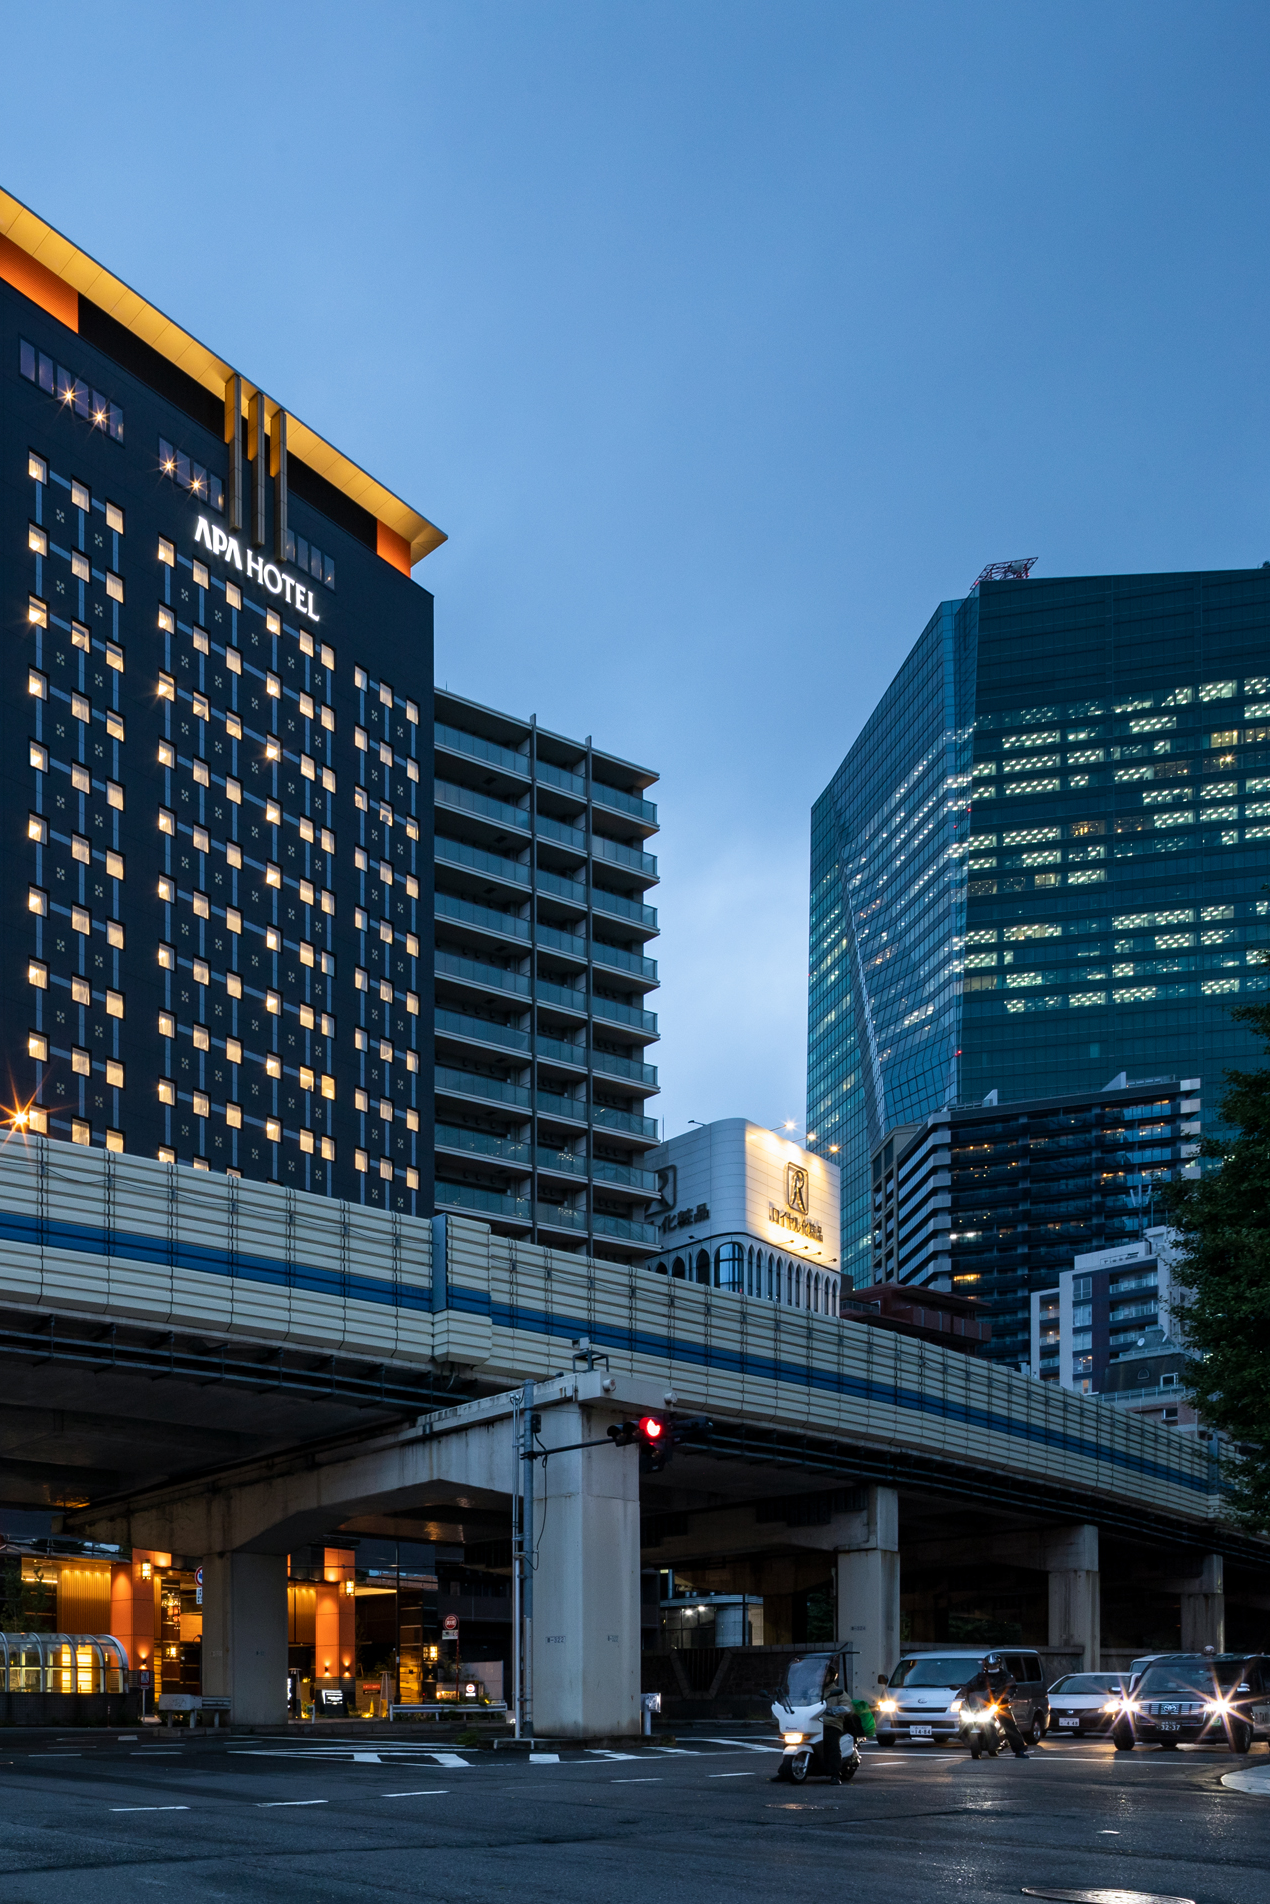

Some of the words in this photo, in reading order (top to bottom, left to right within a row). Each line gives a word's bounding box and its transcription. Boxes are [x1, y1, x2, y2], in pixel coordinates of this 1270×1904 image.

[194, 515, 243, 571] APA
[246, 548, 320, 622] HOTEL
[649, 1203, 710, 1234] 化粧品
